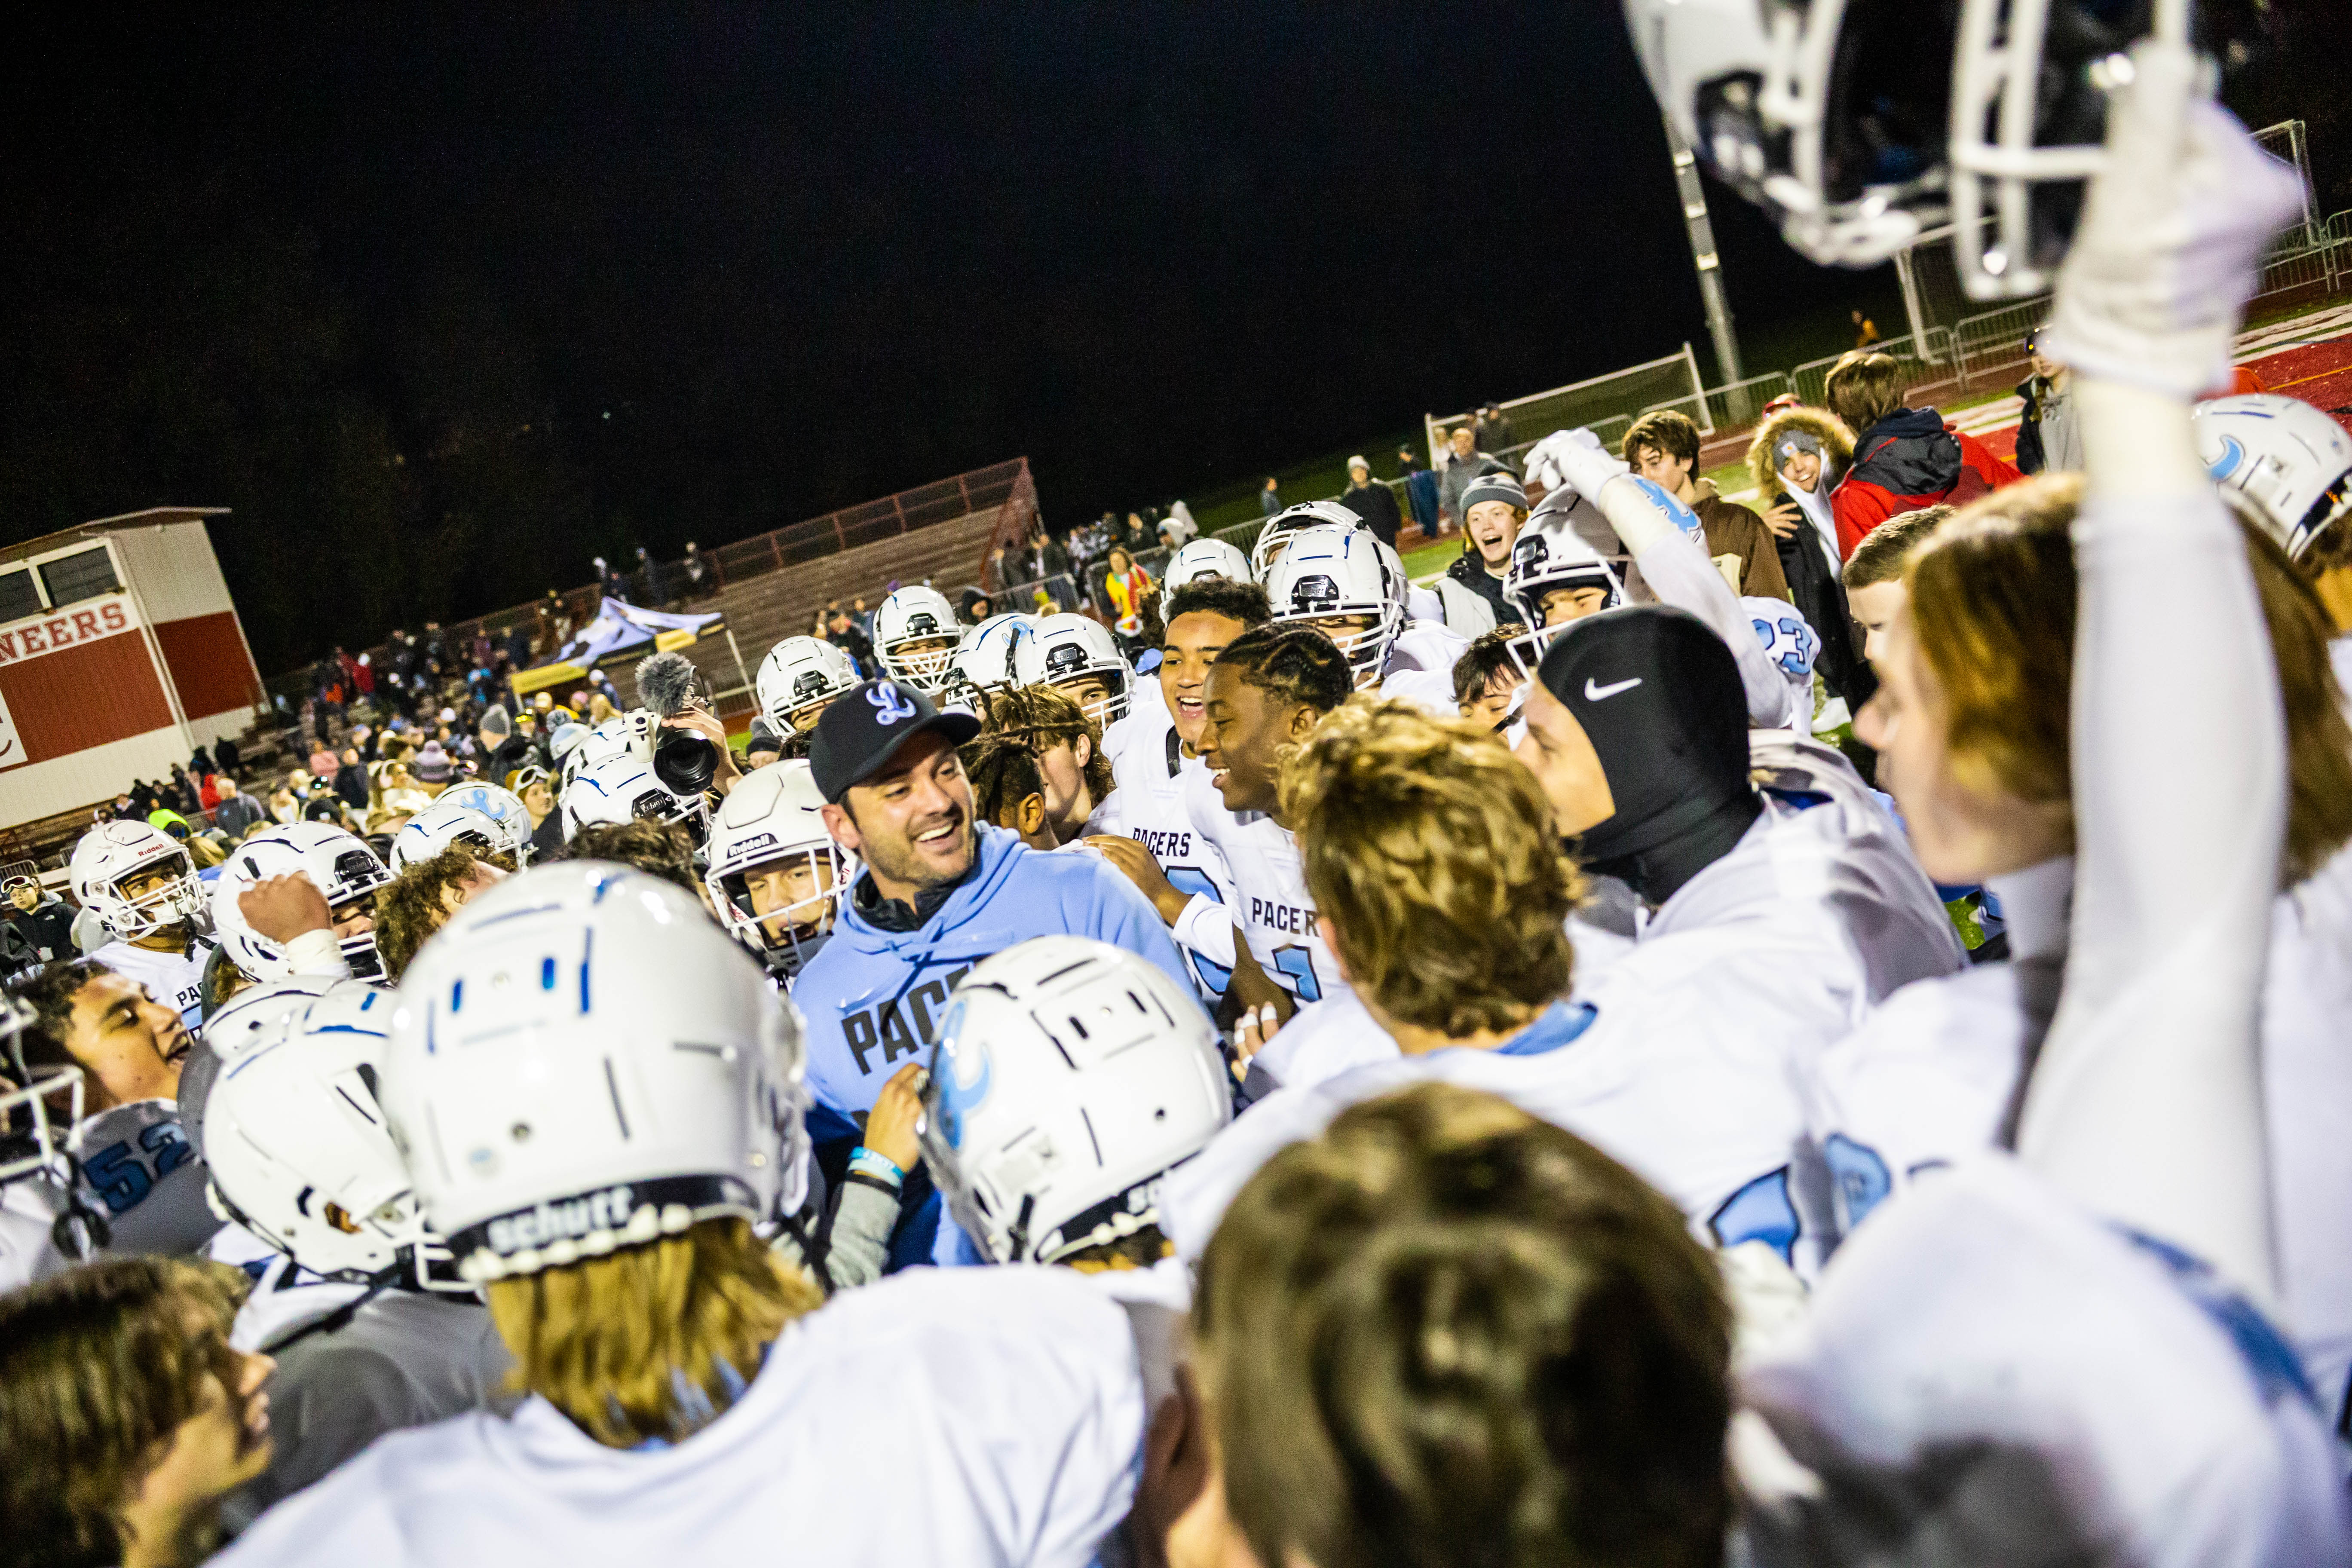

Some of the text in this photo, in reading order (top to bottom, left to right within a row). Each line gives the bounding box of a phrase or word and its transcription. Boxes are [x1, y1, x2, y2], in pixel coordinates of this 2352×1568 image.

[138, 843, 164, 857] Riddell
[729, 834, 770, 857] Riddell
[83, 1119, 197, 1213] 52
